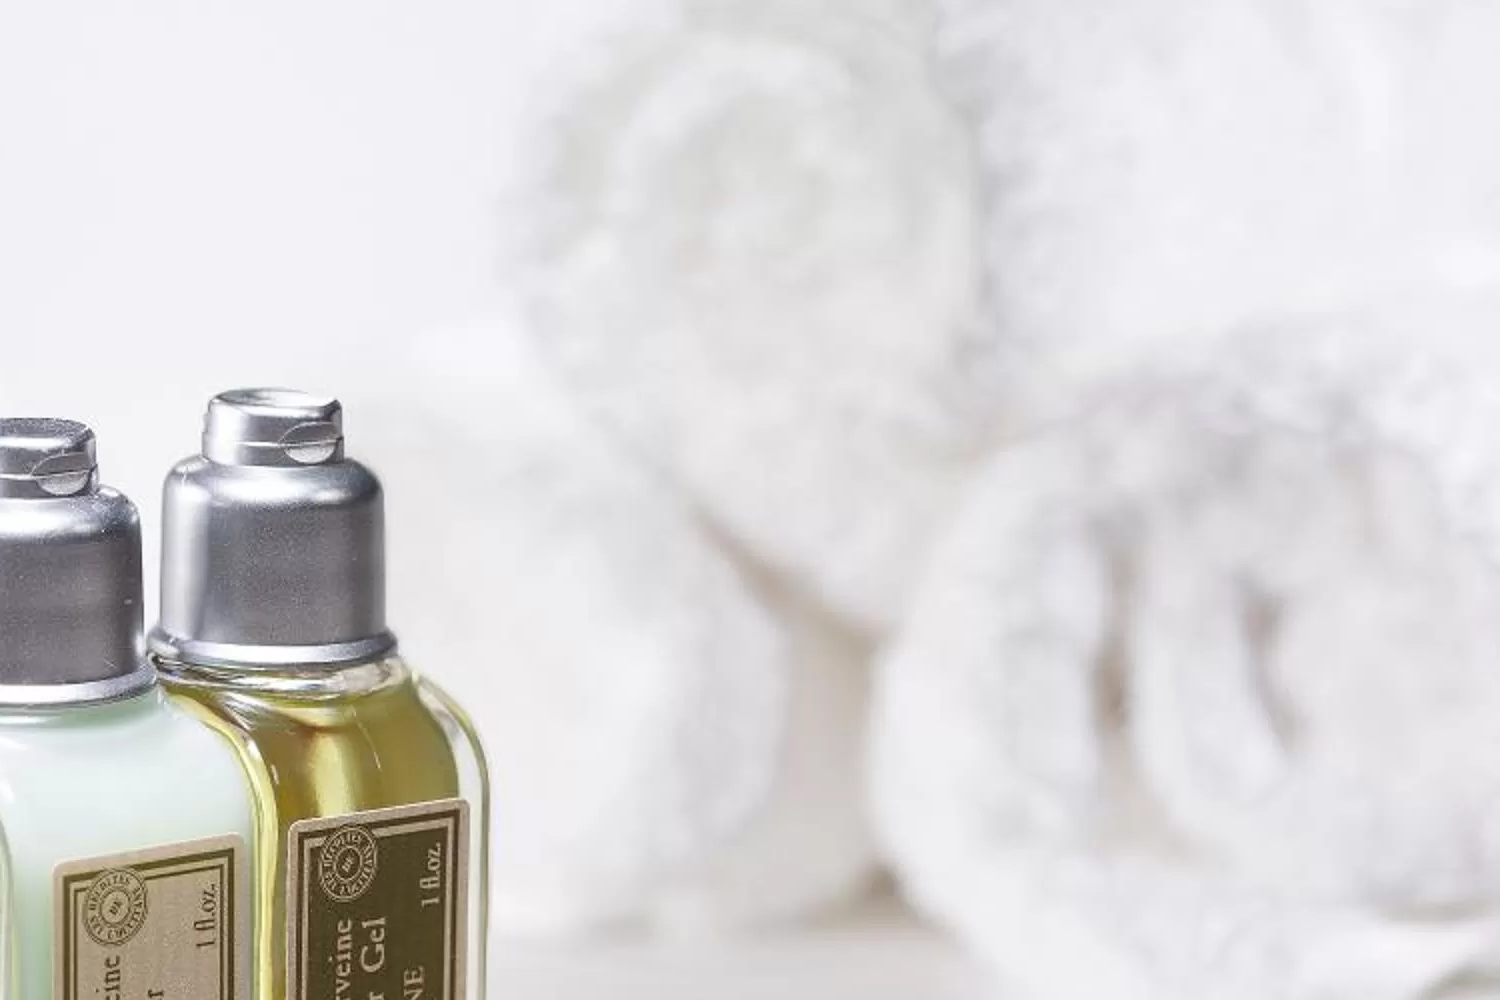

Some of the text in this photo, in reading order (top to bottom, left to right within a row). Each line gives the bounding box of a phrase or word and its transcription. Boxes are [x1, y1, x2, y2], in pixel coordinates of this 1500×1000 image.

[419, 841, 441, 908] 1 fl.oz.
[193, 883, 217, 948] 1 fl.oz.
[360, 916, 386, 973] Gel
